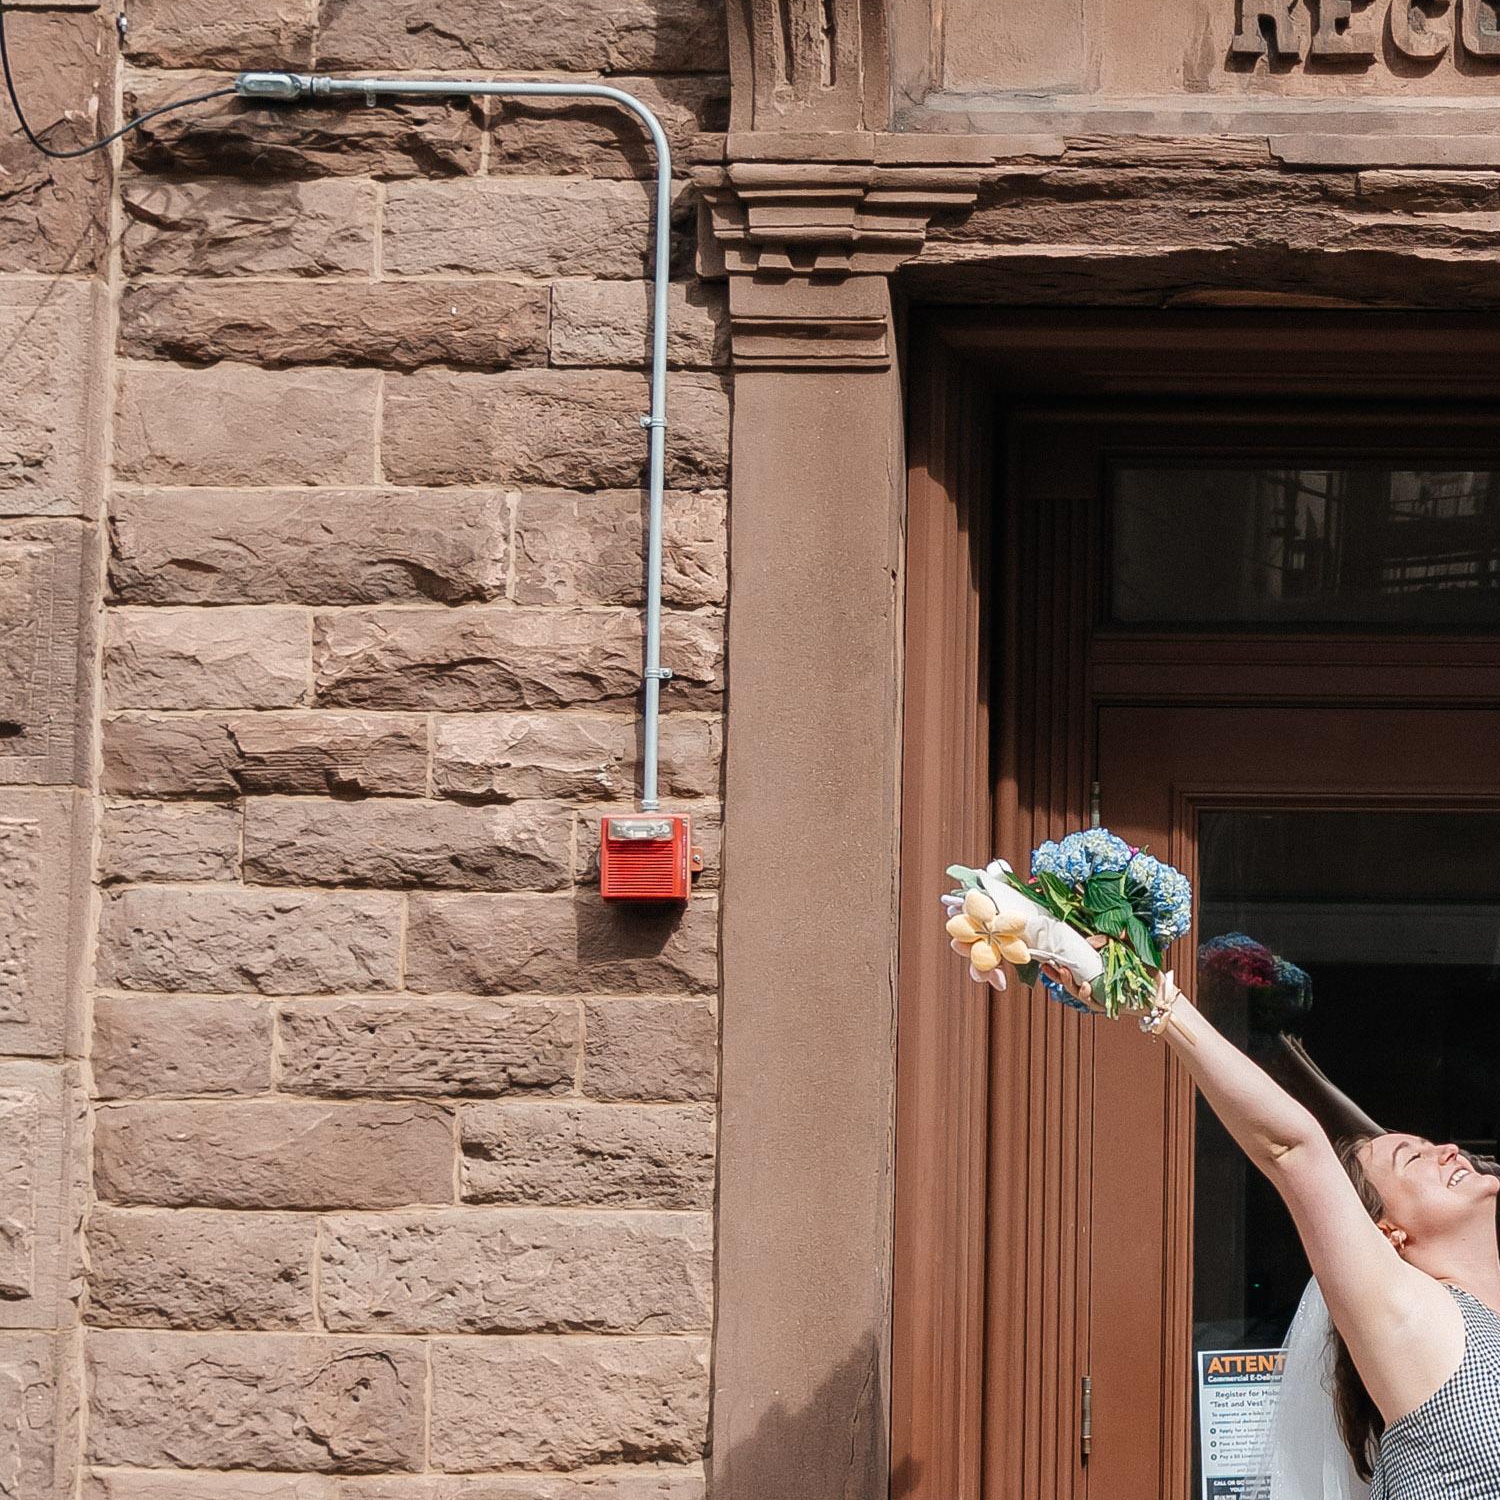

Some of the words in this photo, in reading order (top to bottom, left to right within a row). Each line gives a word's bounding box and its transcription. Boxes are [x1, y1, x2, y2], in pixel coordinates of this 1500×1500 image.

[1215, 1390, 1247, 1399] Register
[1248, 1389, 1260, 1398] for
[1230, 1399, 1245, 1407] and
